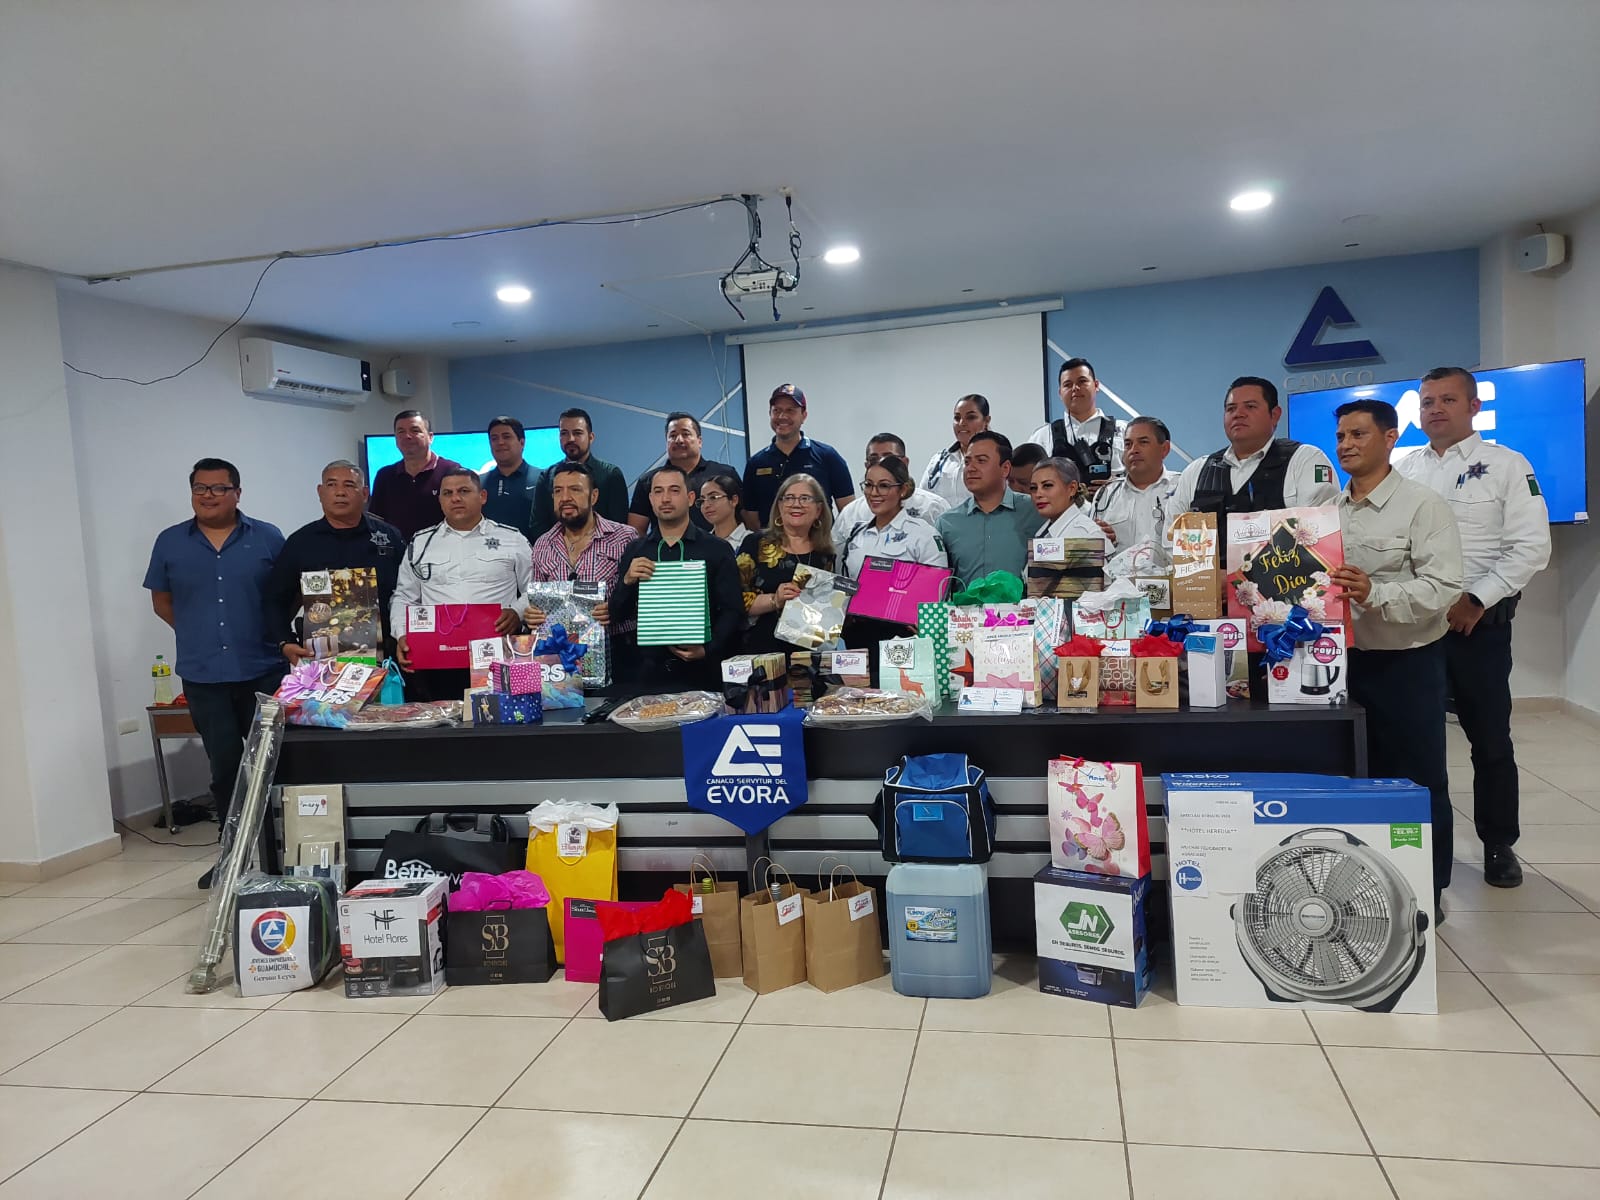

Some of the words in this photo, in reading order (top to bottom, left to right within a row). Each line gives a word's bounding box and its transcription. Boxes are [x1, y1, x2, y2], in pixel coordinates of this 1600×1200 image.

[1283, 371, 1374, 390] CANACO
[1259, 546, 1300, 573] Feliz
[293, 688, 357, 705] EARS
[706, 785, 790, 804] EVORA
[363, 934, 385, 944] Hotel
[386, 933, 409, 943] Flores
[1068, 929, 1100, 939] ASESORES
